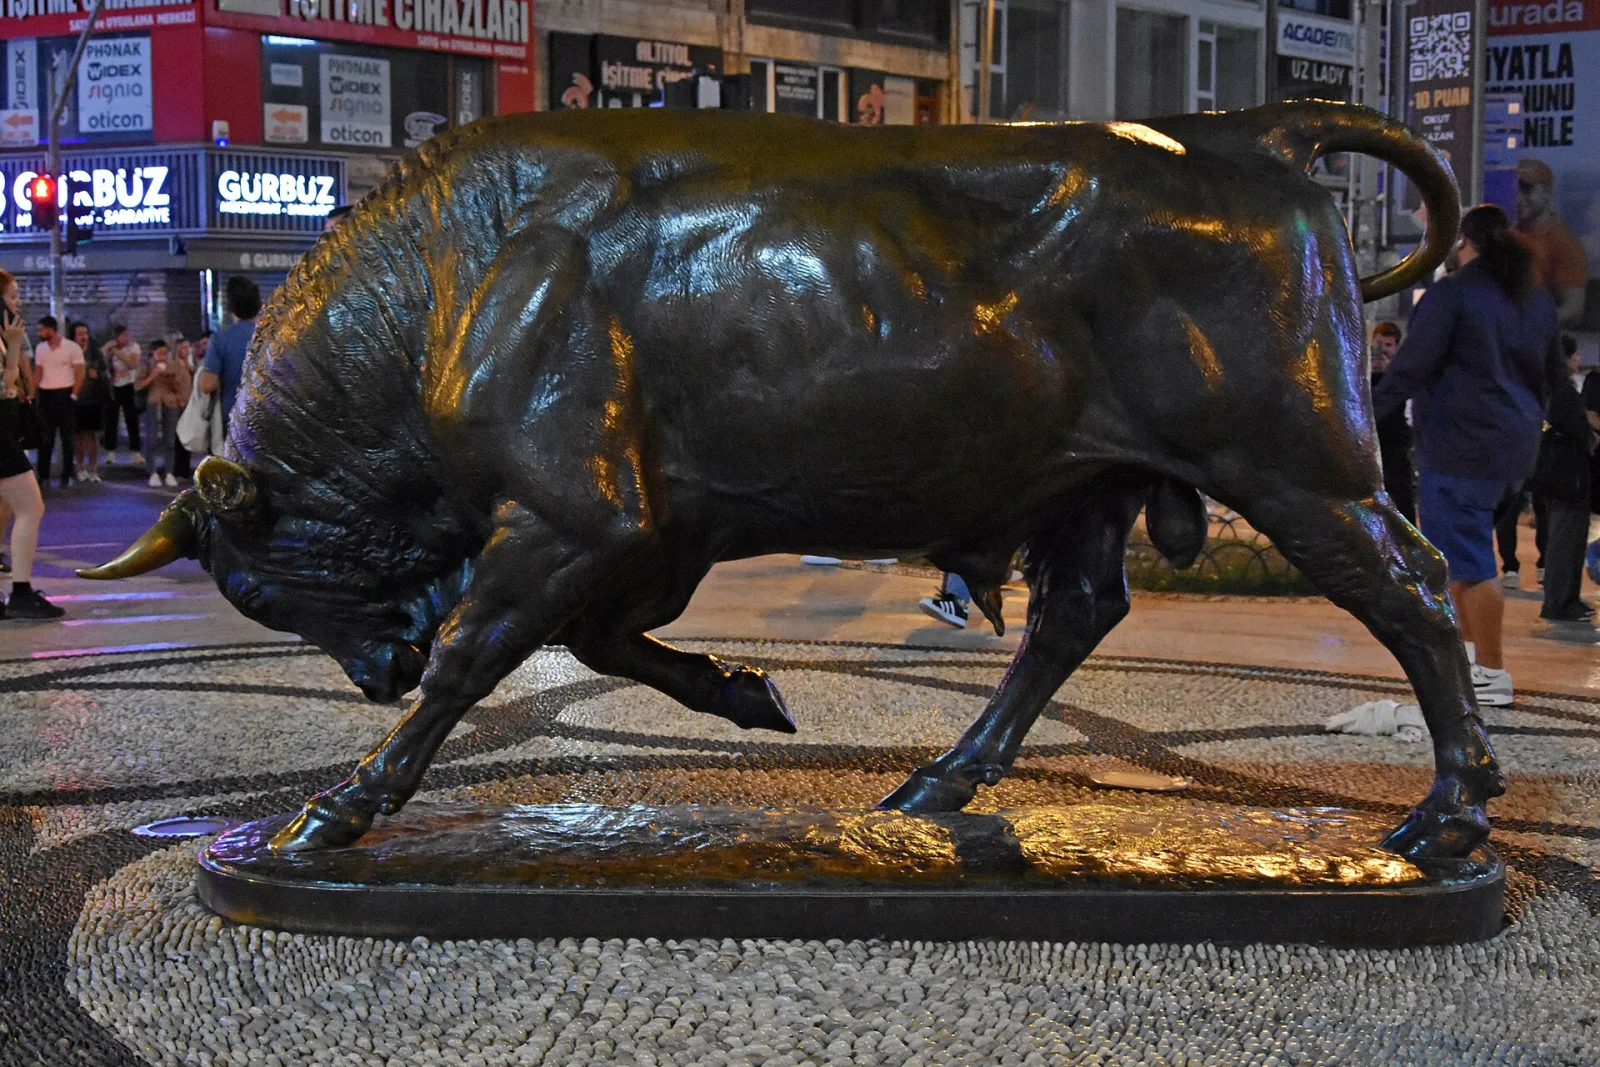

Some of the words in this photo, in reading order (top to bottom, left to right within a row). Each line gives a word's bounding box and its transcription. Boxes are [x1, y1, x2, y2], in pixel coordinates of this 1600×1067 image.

[87, 42, 141, 58] PHONAK
[87, 62, 141, 81] WIDEX
[329, 58, 380, 76] PHONAK
[1313, 63, 1345, 86] LADY
[88, 83, 143, 104] signia
[329, 75, 381, 95] WIDEX
[1434, 87, 1470, 108] PUAN
[88, 111, 143, 129] oticon
[330, 126, 383, 144] oticon
